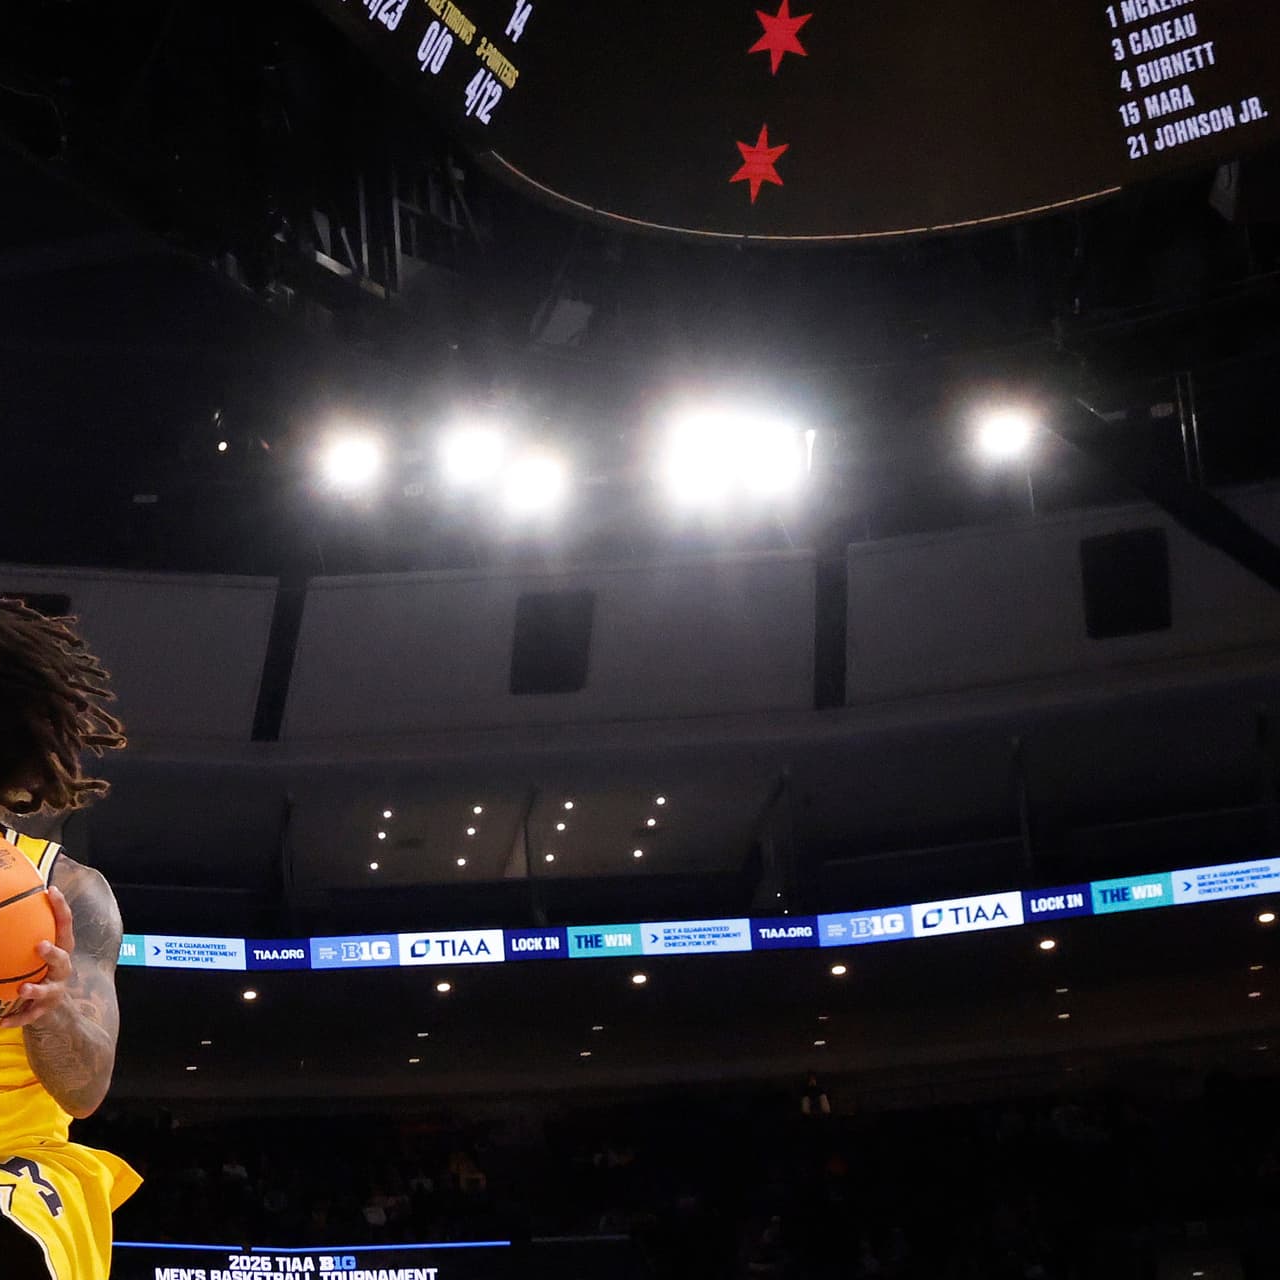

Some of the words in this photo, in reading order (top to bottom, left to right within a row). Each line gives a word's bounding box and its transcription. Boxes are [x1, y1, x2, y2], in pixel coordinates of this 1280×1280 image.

[1105, 5, 1118, 28] 1
[1111, 38, 1125, 61] 3
[1128, 13, 1198, 56] CADEAU
[1120, 69, 1133, 92] 4
[1136, 41, 1216, 88] BURNETT
[464, 67, 503, 125] 4/12
[1119, 101, 1140, 128] 15
[1144, 84, 1196, 120] MARA
[1126, 132, 1149, 160] 21
[1154, 105, 1236, 152] JOHNSON
[1239, 96, 1268, 124] JR.
[851, 913, 904, 938] B1G
[949, 902, 1008, 926] TIAA
[253, 947, 305, 962] TIAA.ORG
[436, 938, 490, 958] TIAA
[229, 1255, 272, 1272] 2026
[276, 1256, 315, 1272] TIAA
[320, 1255, 357, 1271] B1G
